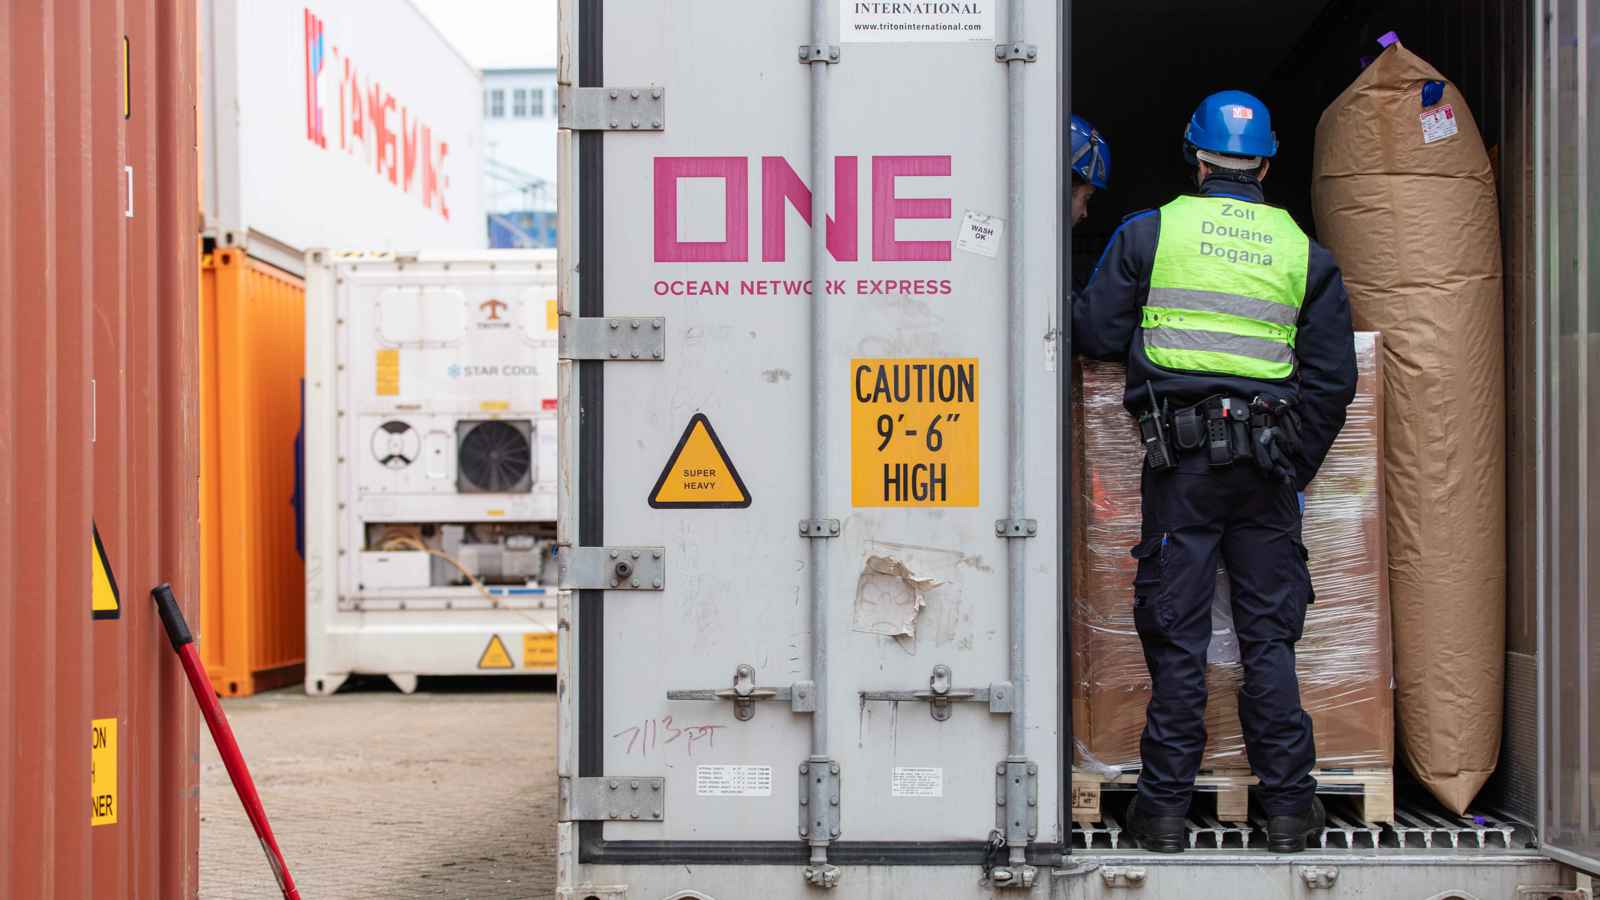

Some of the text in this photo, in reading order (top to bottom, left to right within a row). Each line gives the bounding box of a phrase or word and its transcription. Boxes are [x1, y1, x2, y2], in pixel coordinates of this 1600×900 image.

[855, 2, 982, 14] INTERNATIONAL
[854, 22, 982, 31] www.tritoninternational.com
[653, 155, 952, 262] ONE
[1221, 204, 1255, 220] Zoll
[975, 232, 986, 241] OK
[1201, 221, 1272, 243] Douane
[1200, 242, 1272, 265] Dogana
[653, 280, 730, 296] OCEAN
[856, 280, 953, 295] EXPRESS
[855, 364, 975, 403] CAUTION
[683, 469, 717, 478] SUPER
[684, 482, 716, 490] HEAVY
[884, 463, 947, 502] HIGH
